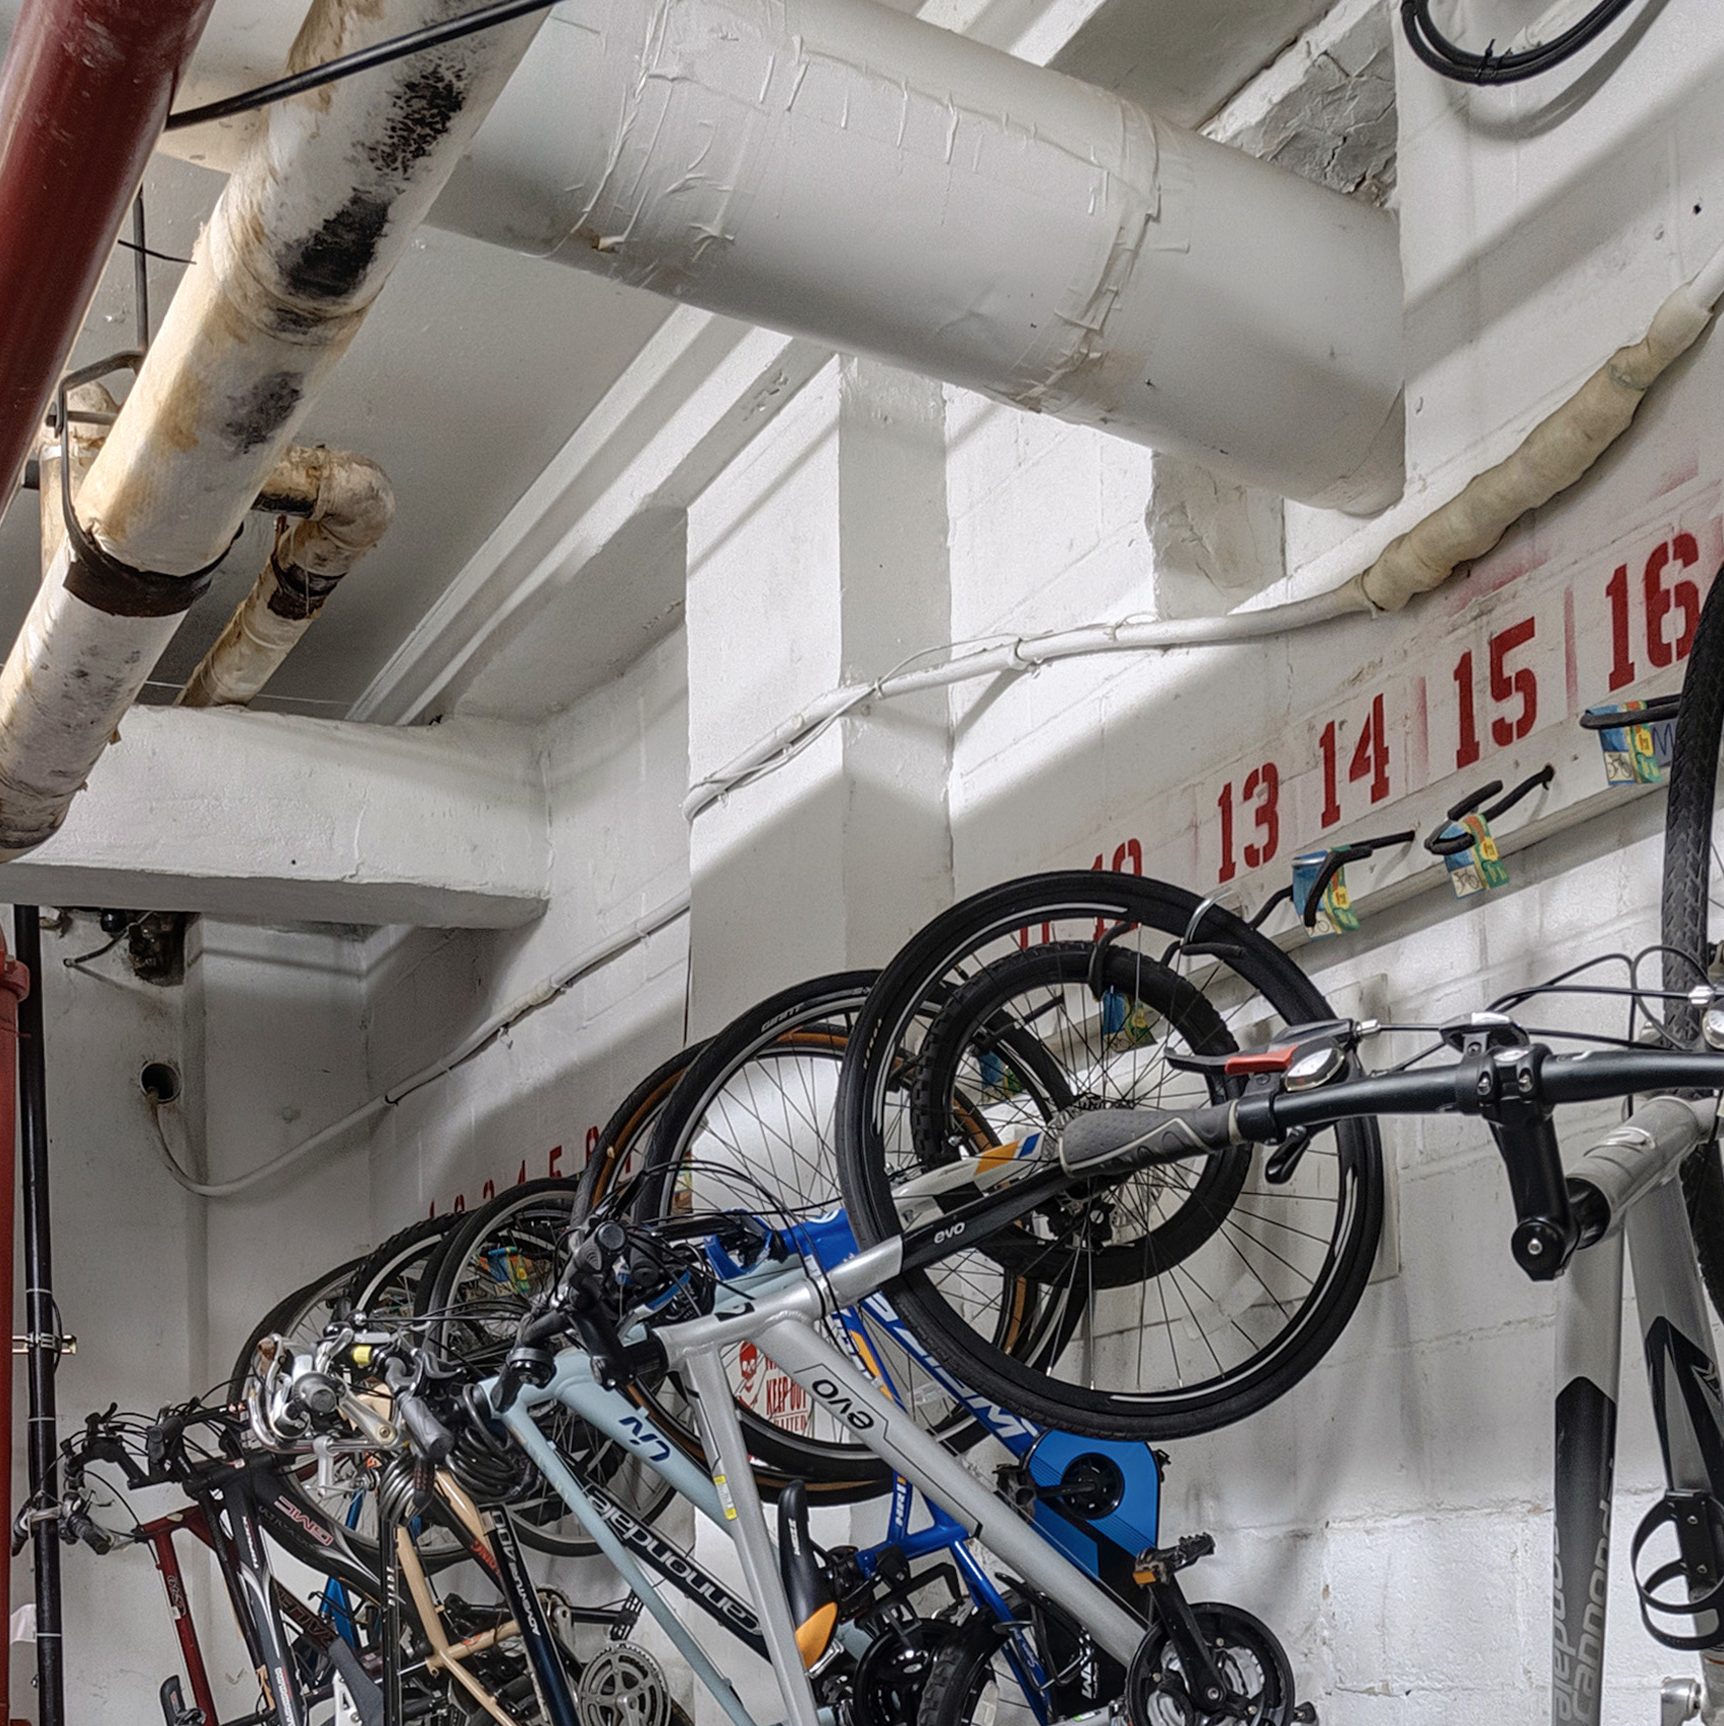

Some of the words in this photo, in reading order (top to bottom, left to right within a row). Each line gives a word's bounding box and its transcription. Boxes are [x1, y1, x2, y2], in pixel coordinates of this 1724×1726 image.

[1605, 532, 1700, 692] 16
[1453, 616, 1538, 769] 15
[1217, 761, 1279, 884] 13
[1318, 693, 1390, 829] 14
[933, 1220, 966, 1244] evo
[812, 1379, 875, 1430] evo
[274, 1495, 334, 1546] GMC
[587, 1486, 762, 1635] cannondale
